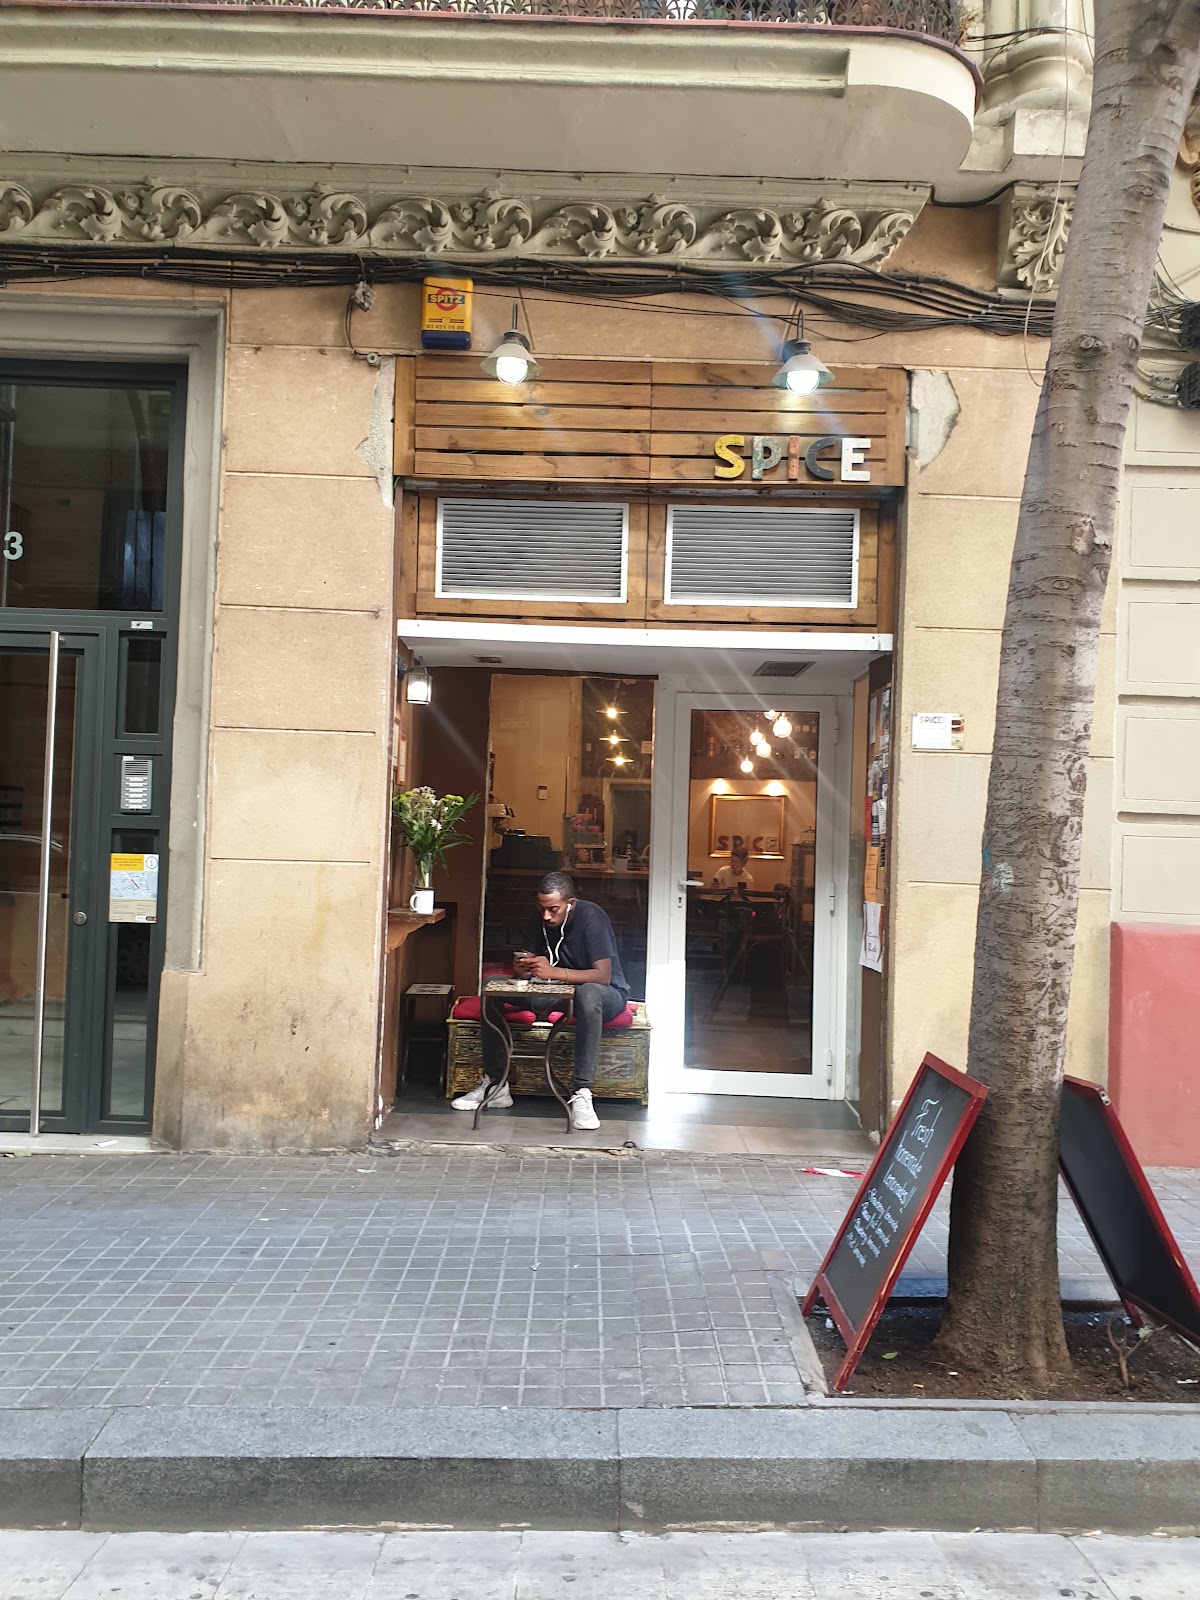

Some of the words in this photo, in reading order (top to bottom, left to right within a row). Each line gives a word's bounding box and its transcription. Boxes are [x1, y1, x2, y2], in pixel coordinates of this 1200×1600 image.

[430, 295, 462, 303] SPITZ
[714, 434, 872, 482] SPICE
[3, 531, 24, 560] 3
[920, 716, 943, 724] SPICE
[911, 1099, 943, 1148] Fresh
